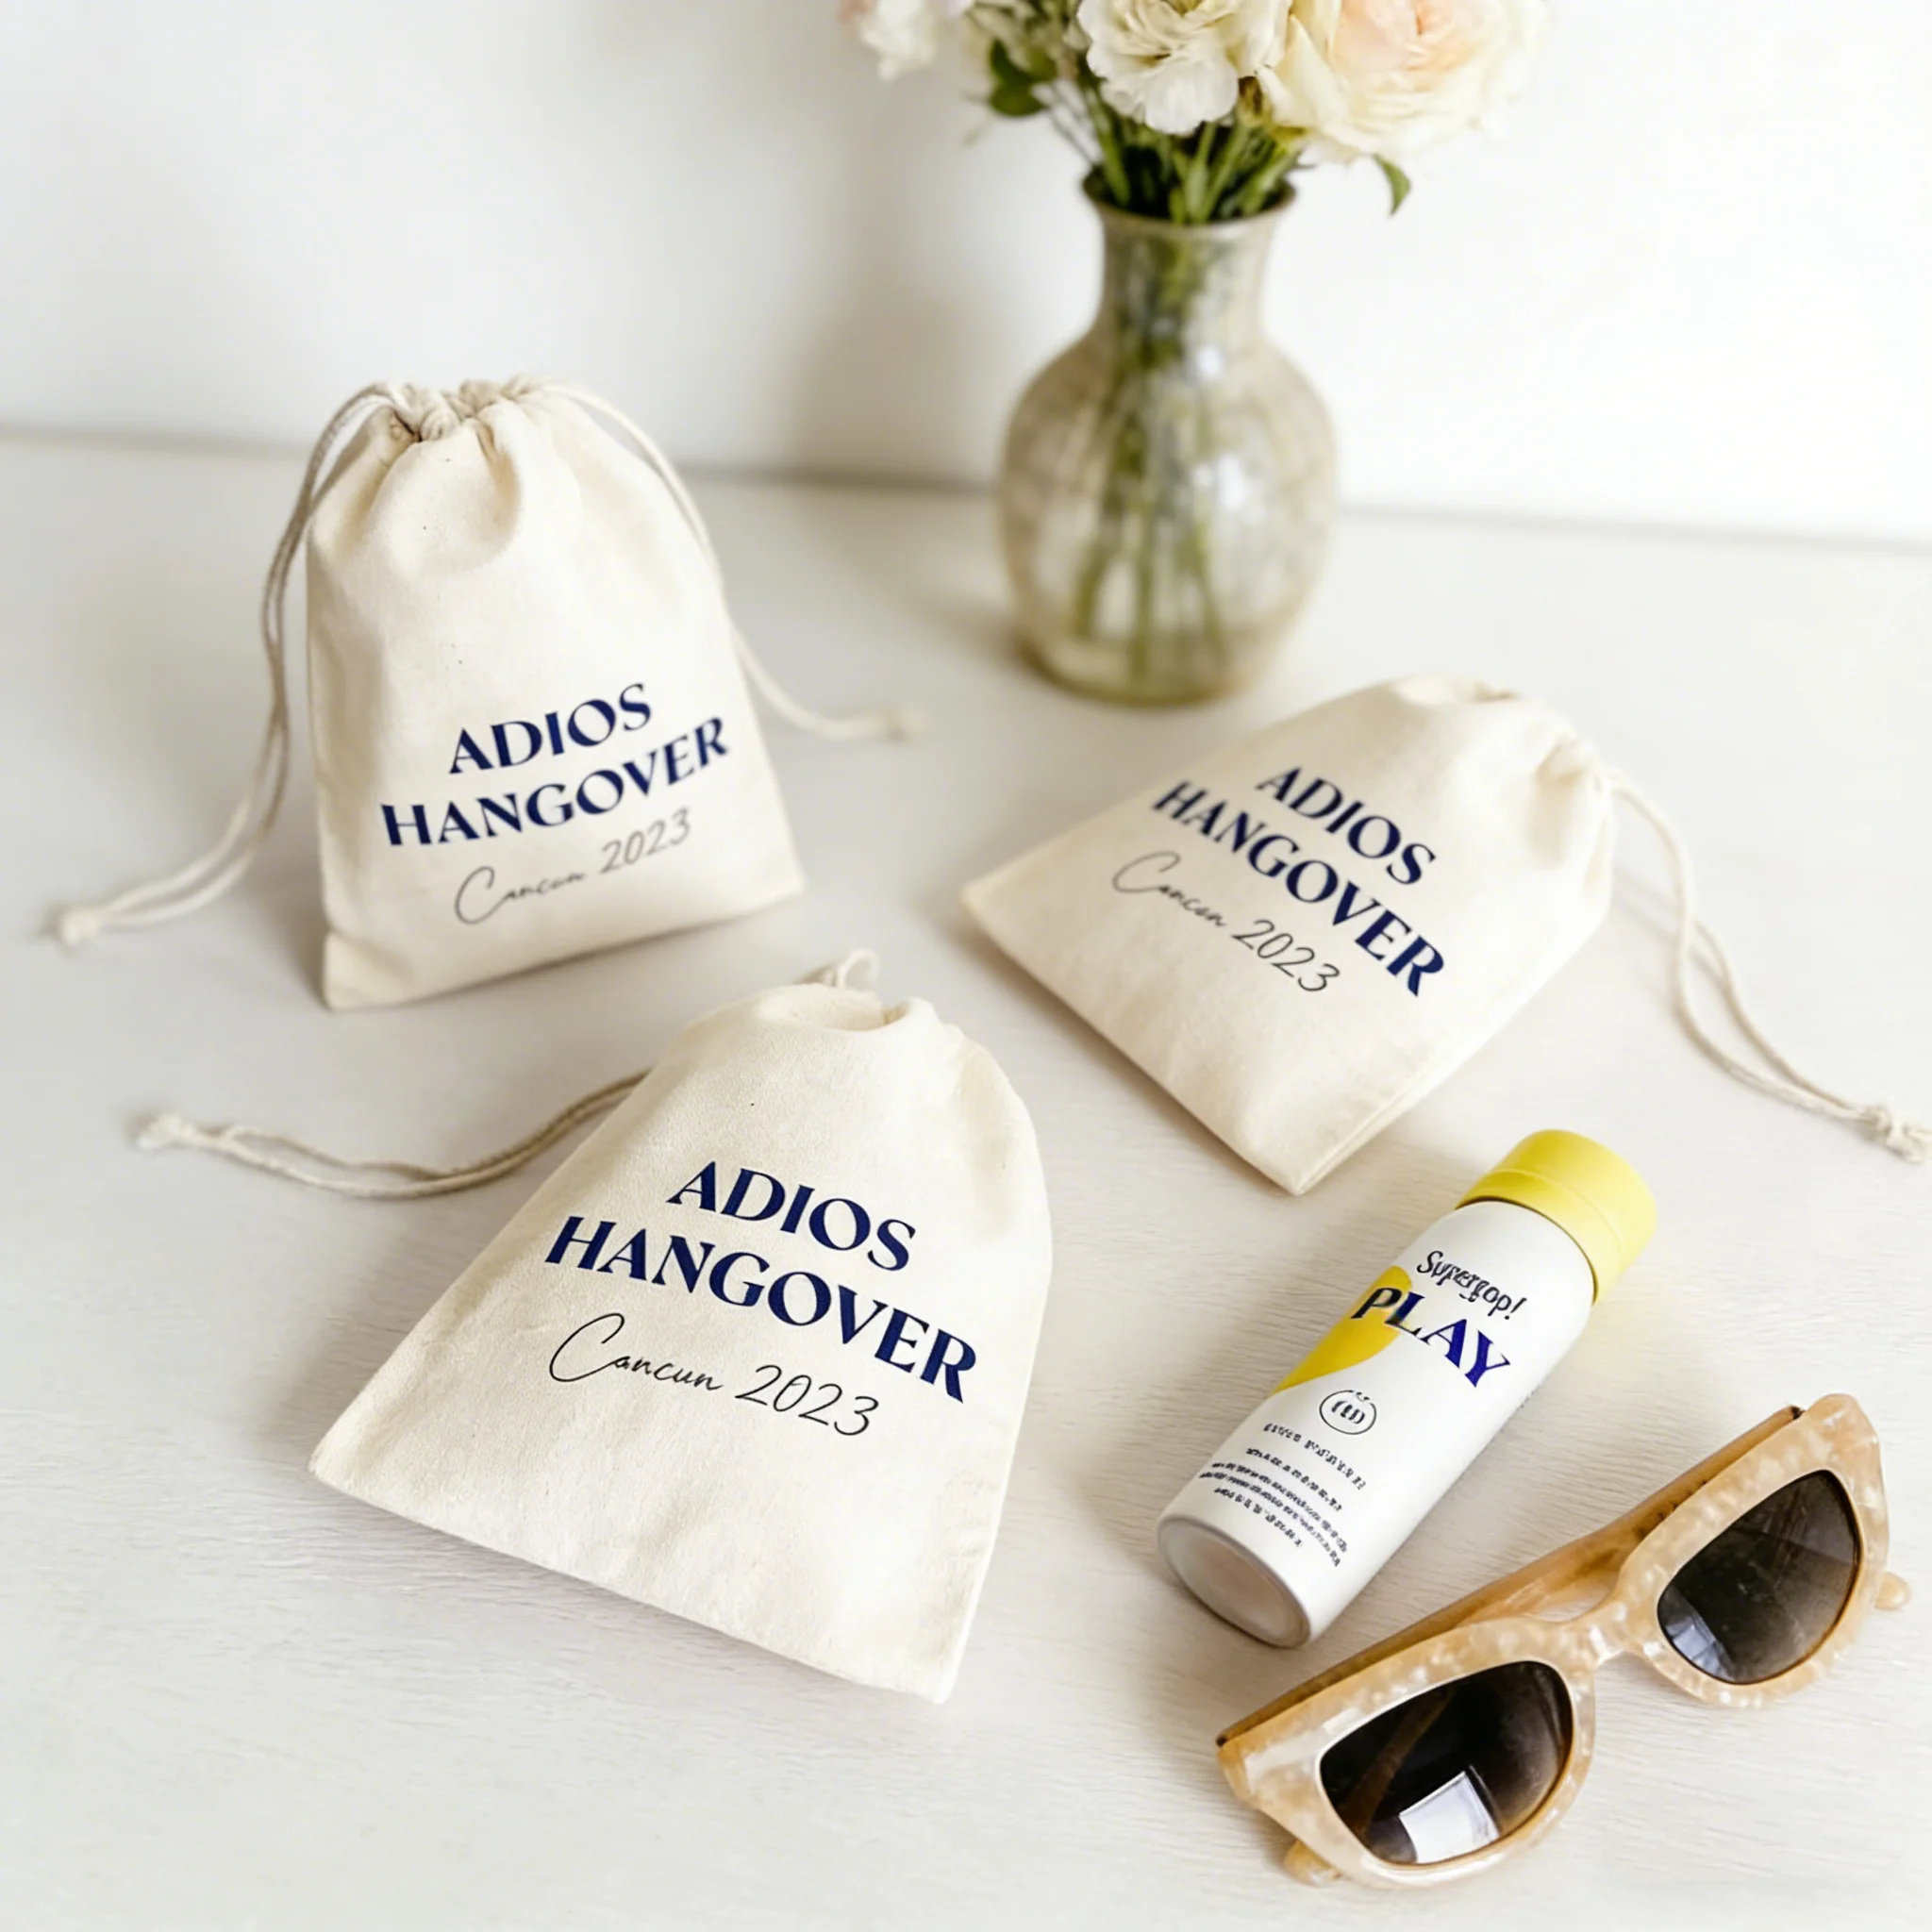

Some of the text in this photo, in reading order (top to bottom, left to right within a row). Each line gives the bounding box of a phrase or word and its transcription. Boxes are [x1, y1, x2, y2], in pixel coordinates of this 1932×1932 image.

[381, 717, 729, 845] HANGOVER
[449, 683, 651, 774] ADIOS
[600, 808, 691, 874] 2023
[1255, 766, 1436, 884] ADIOS
[1151, 780, 1444, 997] HANGOVER
[1231, 920, 1340, 991] 2023
[666, 1161, 916, 1271] ADIOS
[545, 1216, 976, 1403] HANGOVER
[1351, 1288, 1510, 1388] PLAY
[549, 1313, 878, 1436] Cancun 2023
